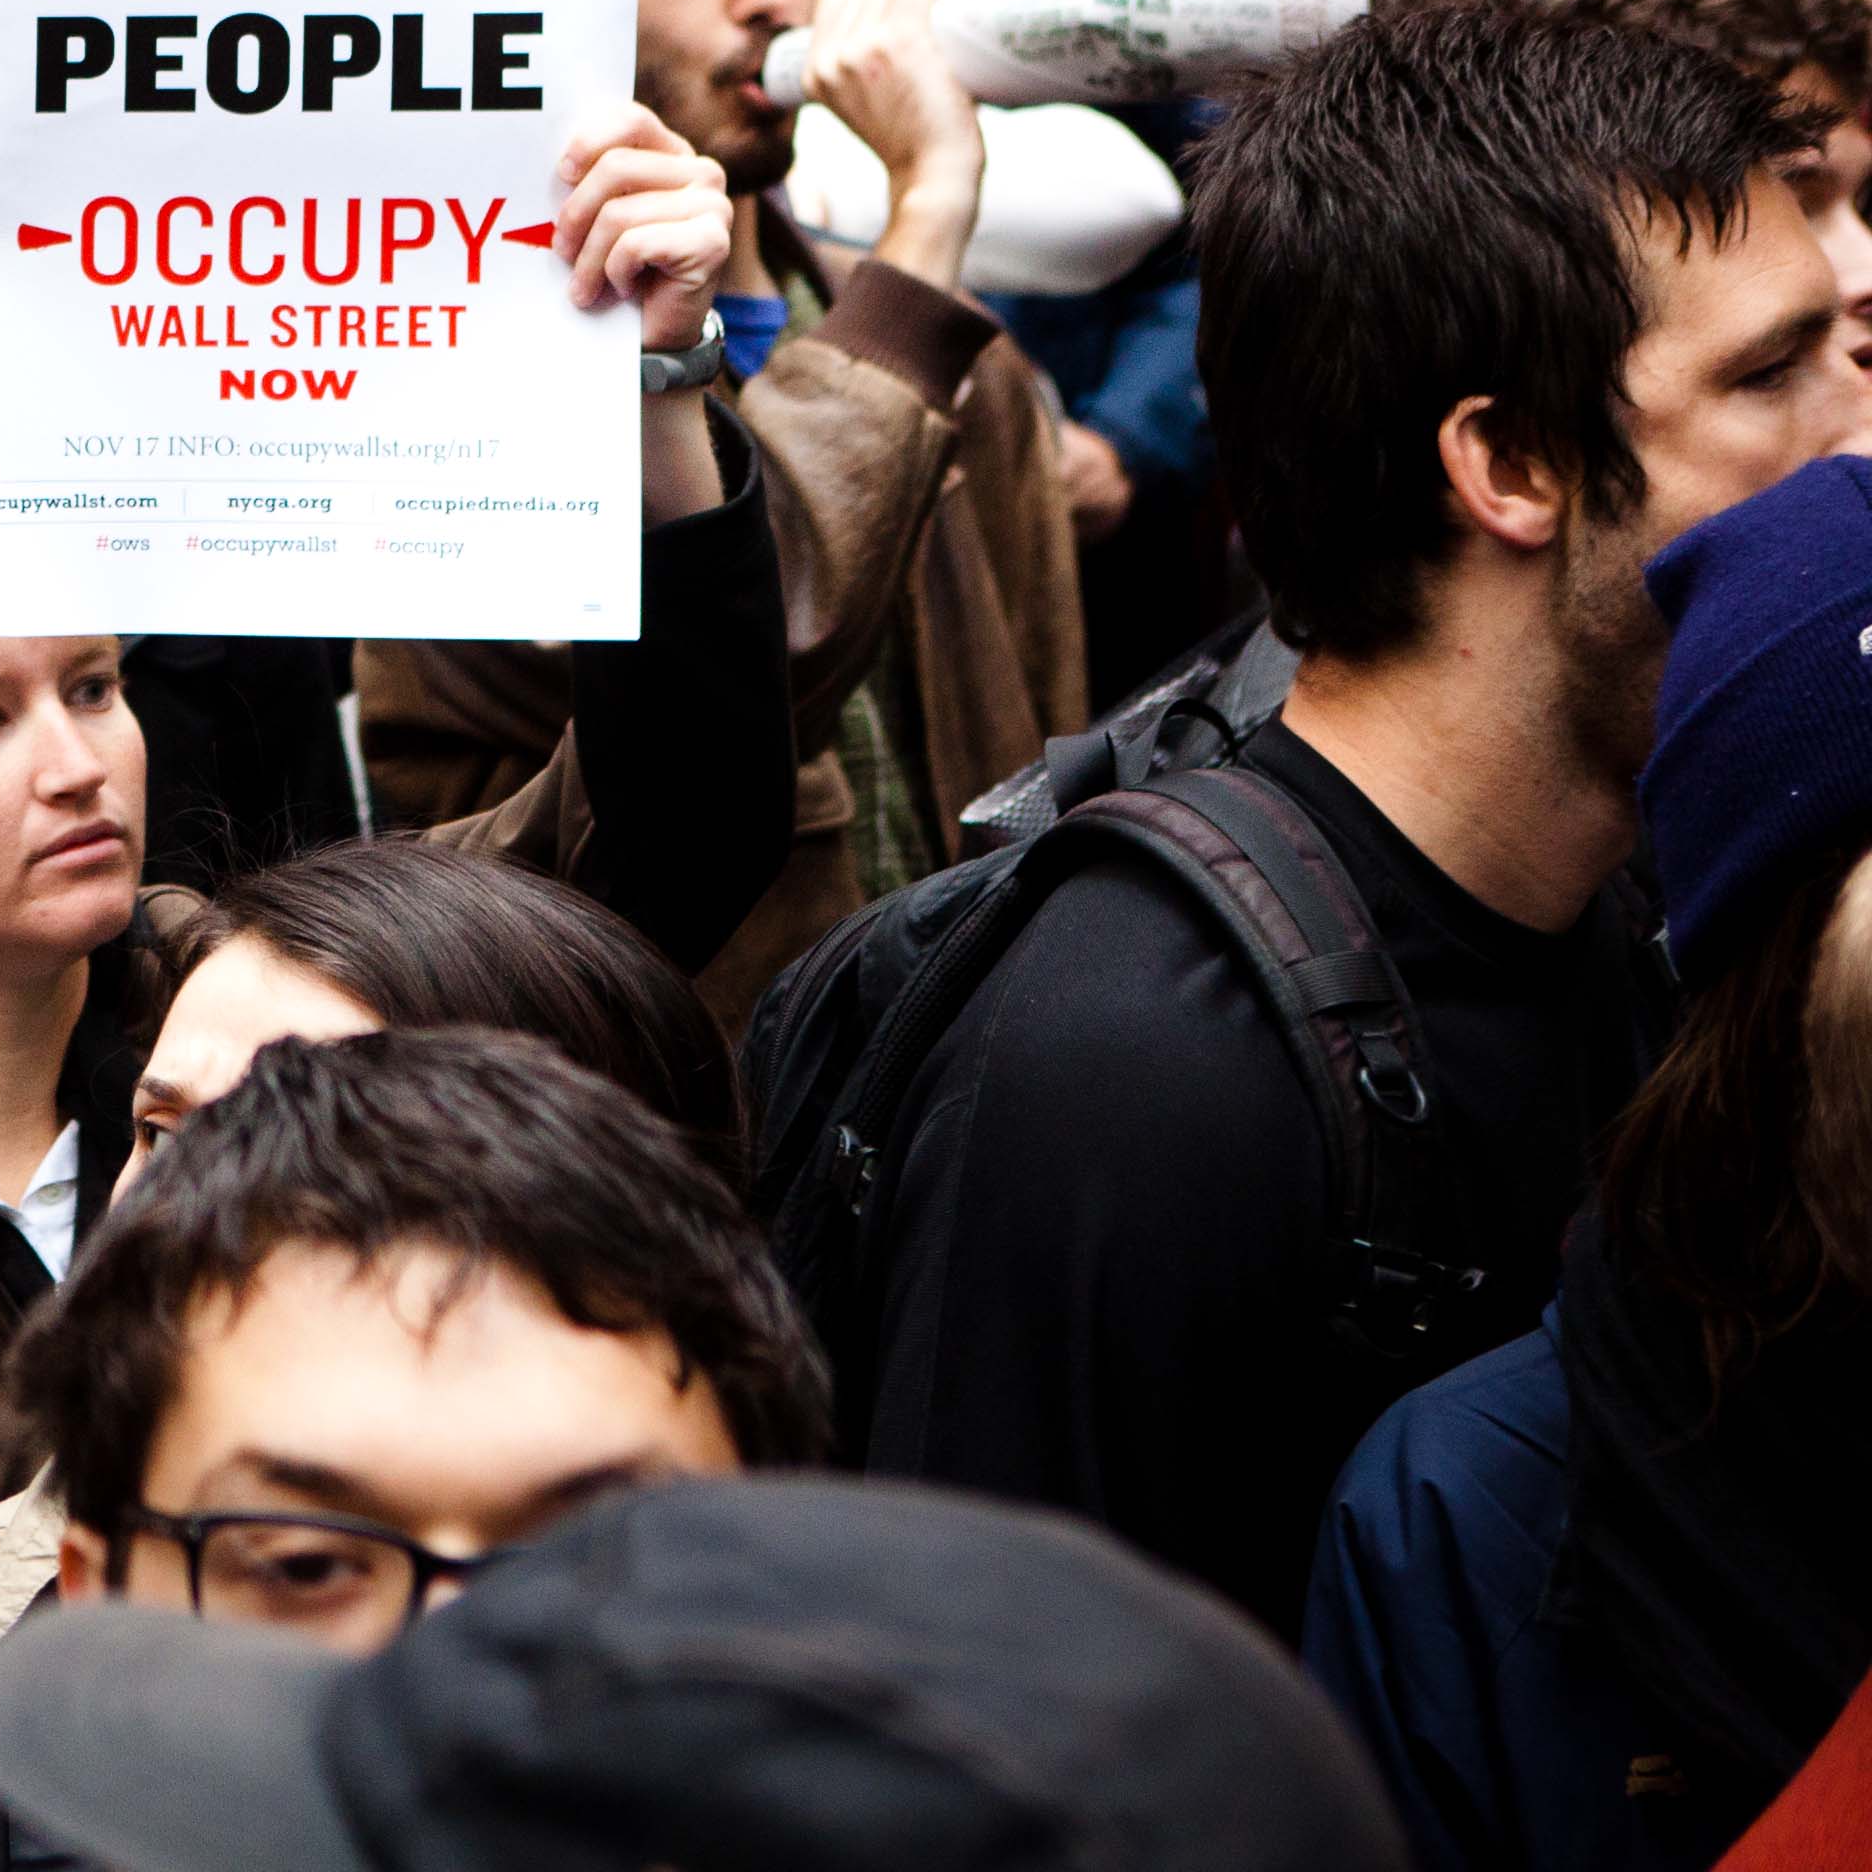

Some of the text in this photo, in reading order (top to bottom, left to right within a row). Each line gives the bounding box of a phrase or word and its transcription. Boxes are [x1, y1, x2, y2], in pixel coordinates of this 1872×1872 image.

[35, 12, 544, 115] PEOPLE
[79, 195, 506, 286] OCCUPY
[110, 304, 467, 349] WALL STREET
[218, 368, 358, 402] NOW
[63, 434, 500, 465] NOV 17 INFO: occupywallst.org/n17
[226, 493, 333, 514] nycga.org
[394, 494, 601, 517] occupiedmedia.org
[95, 534, 465, 560] #ows #occupywallst #occupy
